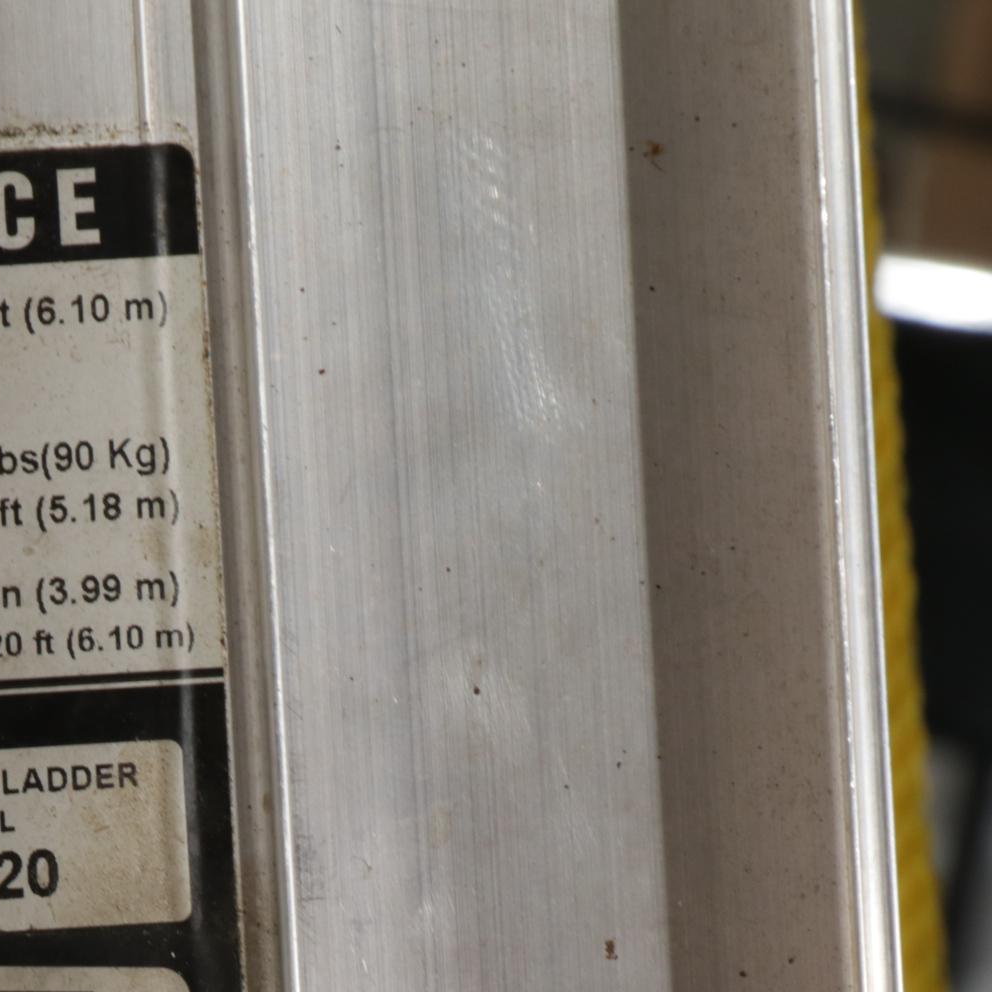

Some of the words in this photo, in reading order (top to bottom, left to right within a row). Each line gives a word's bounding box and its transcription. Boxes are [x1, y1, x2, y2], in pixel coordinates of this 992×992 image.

[24, 296, 109, 333] (6.10
[126, 291, 167, 326] m)
[109, 437, 171, 475] Kg)
[0, 497, 23, 526] ft
[37, 493, 122, 532] (5.18
[137, 490, 180, 524] m)
[36, 576, 122, 613] (3.99
[137, 572, 180, 607] m)
[33, 629, 54, 656] ft
[67, 625, 144, 660] (6.10
[157, 623, 196, 653] m)
[2, 763, 139, 795] LADDER
